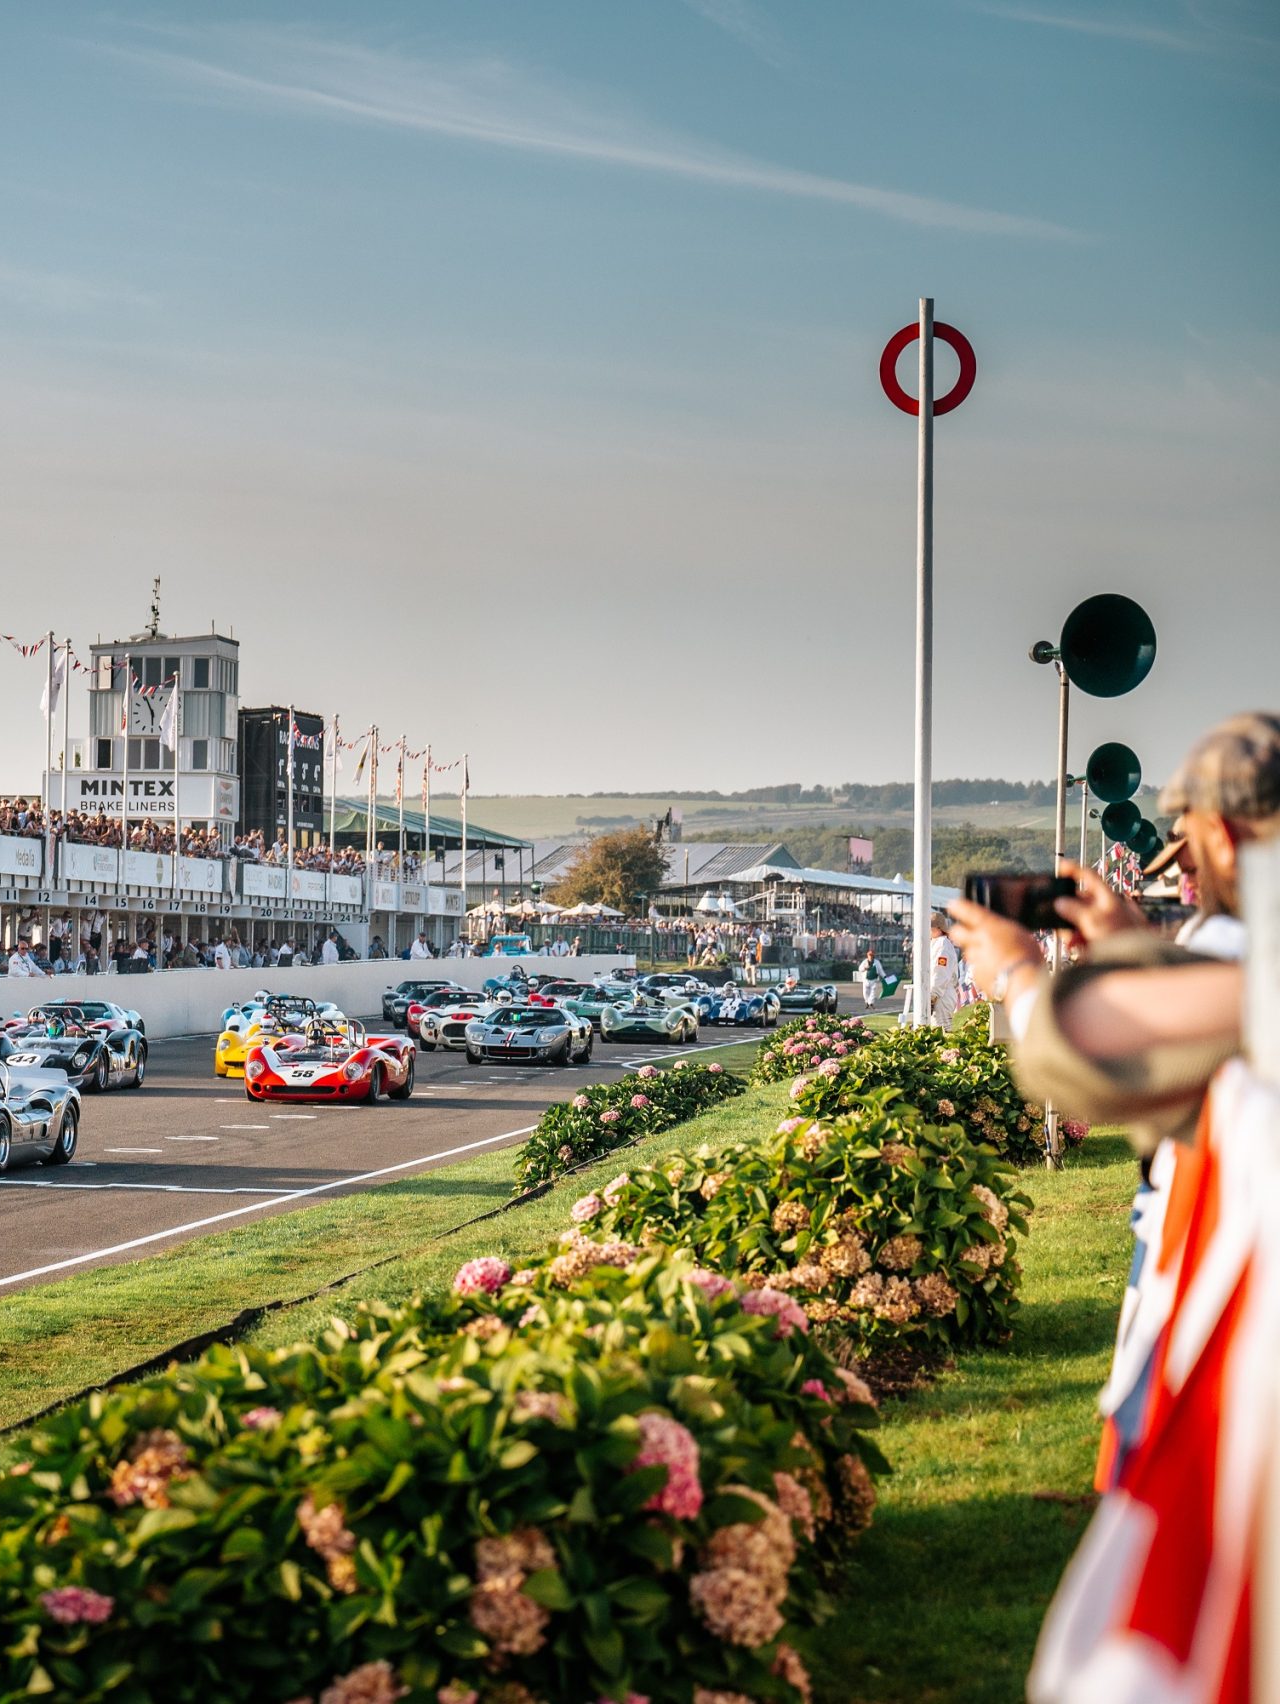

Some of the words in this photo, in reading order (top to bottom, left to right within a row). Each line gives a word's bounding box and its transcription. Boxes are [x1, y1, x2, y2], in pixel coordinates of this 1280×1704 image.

[81, 780, 175, 797] MINTEX
[81, 801, 123, 811] BRAKE
[128, 802, 175, 812] LINERS
[6, 890, 17, 900] 11
[38, 892, 50, 902] 12
[85, 895, 96, 905] 14
[115, 898, 126, 907] 15
[143, 900, 154, 909] 16
[169, 901, 180, 910] 17
[195, 903, 206, 912] 18
[220, 905, 230, 914] 19
[261, 908, 272, 917] 20
[284, 910, 293, 918] 21
[302, 911, 313, 919] 22
[322, 912, 333, 921] 23
[340, 914, 351, 922] 24
[358, 915, 368, 923] 25
[9, 1055, 37, 1064] 44
[291, 1070, 315, 1078] 58
